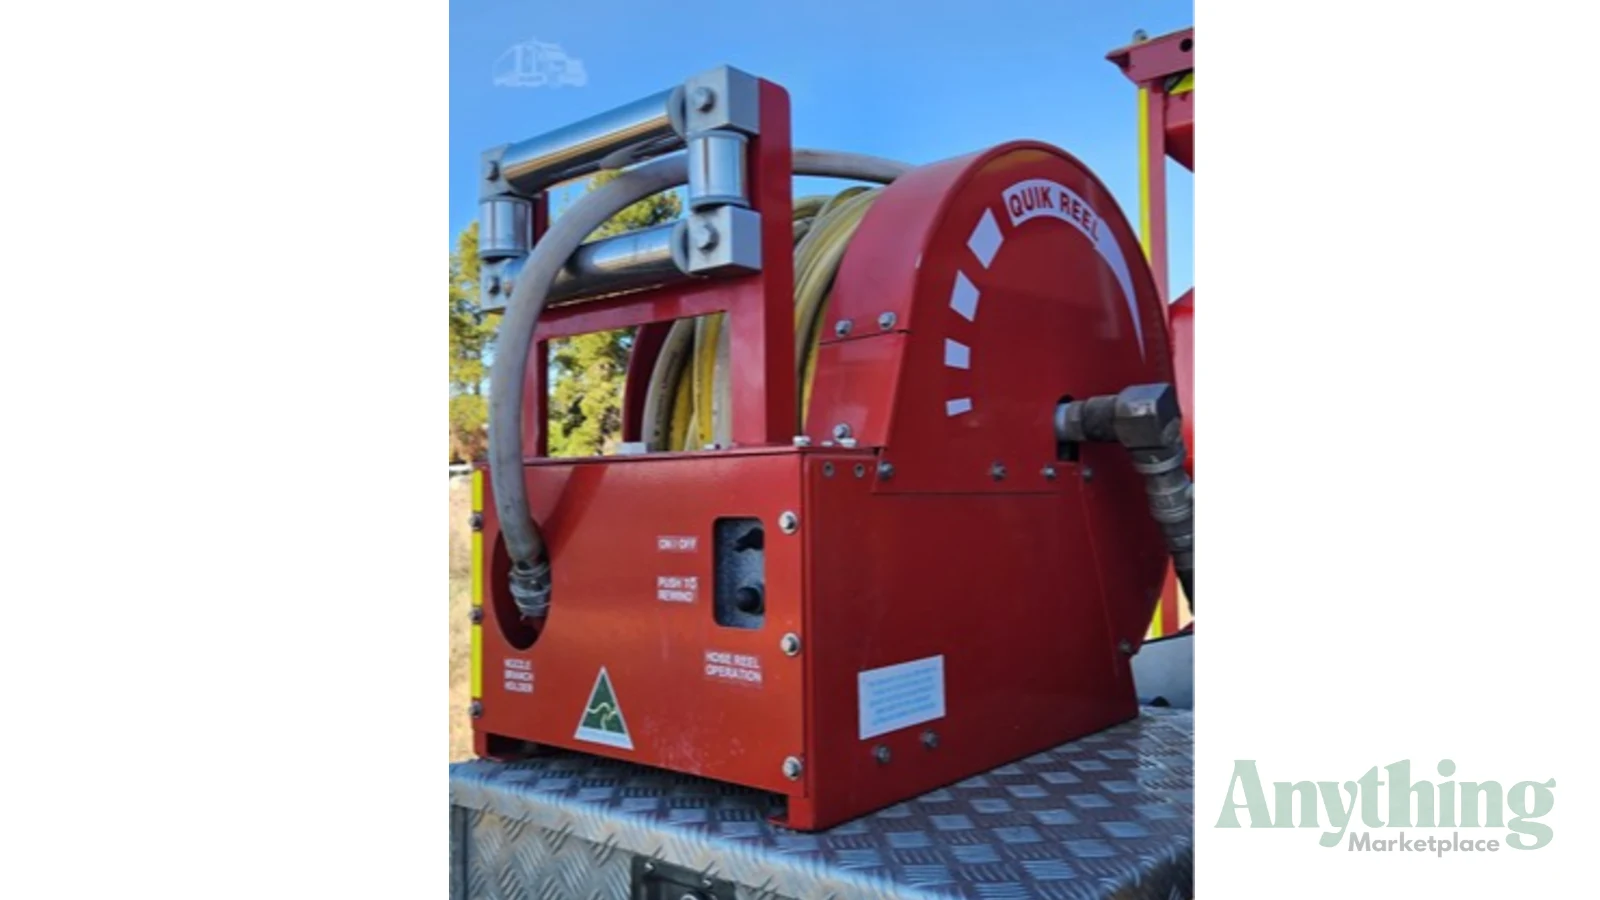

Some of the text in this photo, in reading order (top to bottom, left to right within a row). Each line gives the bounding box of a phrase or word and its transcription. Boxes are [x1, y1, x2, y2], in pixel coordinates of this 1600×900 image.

[1009, 185, 1099, 242] QUIK REEL
[657, 577, 698, 590] PUSH TO
[706, 652, 759, 668] HOSE REEL
[705, 665, 762, 682] OPERATION
